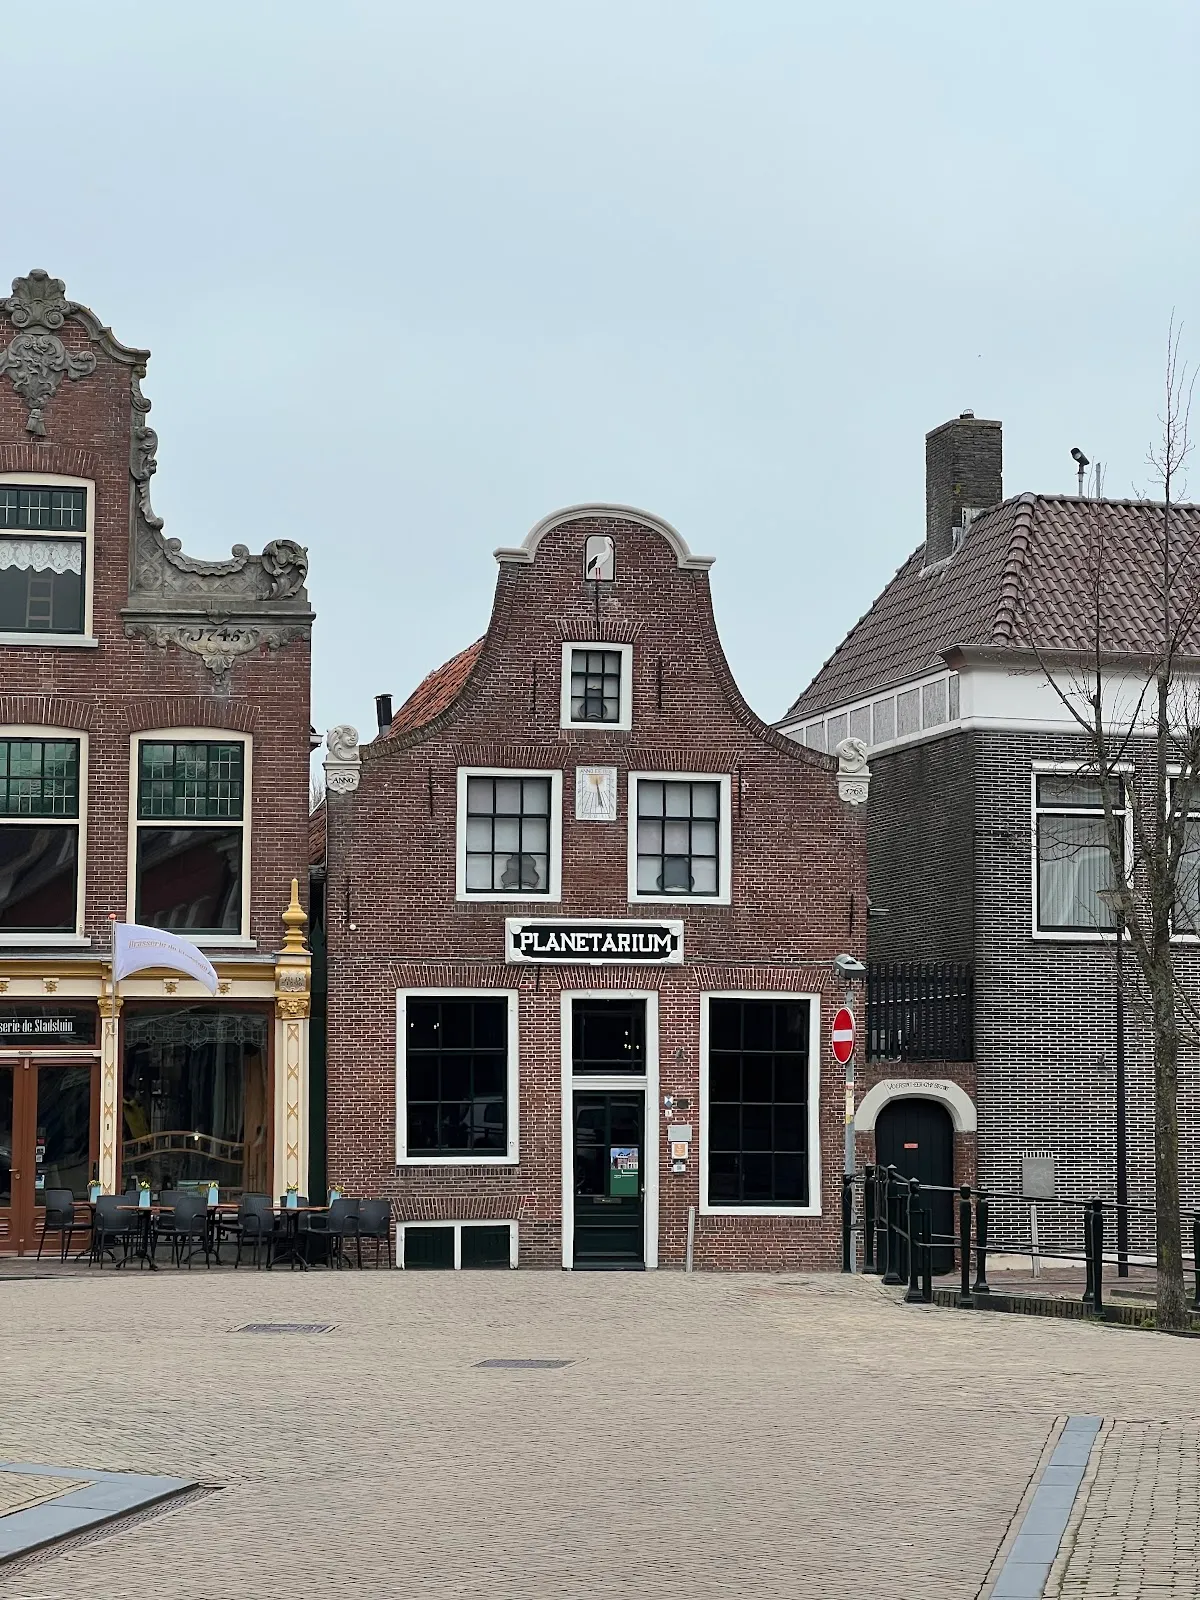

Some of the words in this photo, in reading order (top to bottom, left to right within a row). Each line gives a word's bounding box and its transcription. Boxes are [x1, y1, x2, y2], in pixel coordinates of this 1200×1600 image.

[520, 932, 672, 952] PLANETARIUM
[22, 1019, 33, 1032] de
[34, 1018, 73, 1033] Stadstuin
